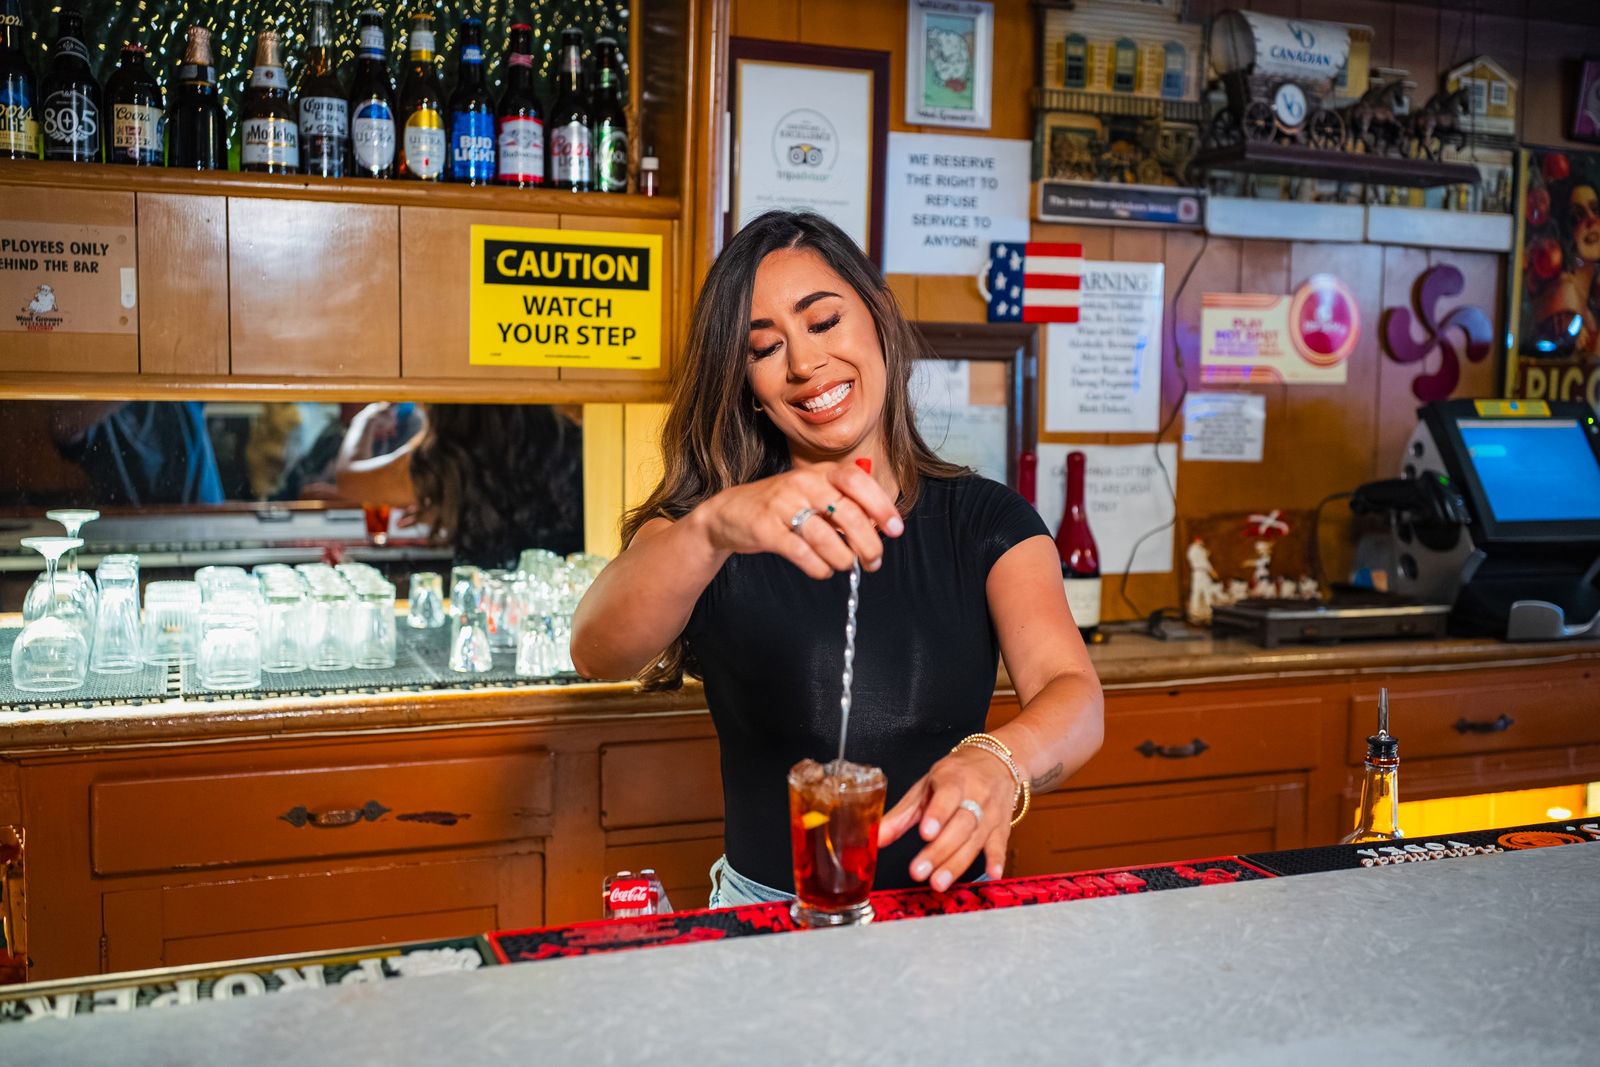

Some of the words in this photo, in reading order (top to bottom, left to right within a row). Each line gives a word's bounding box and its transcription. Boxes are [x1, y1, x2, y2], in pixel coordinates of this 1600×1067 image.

[1269, 45, 1330, 65] CANADIAN
[44, 107, 98, 137] 805
[460, 135, 493, 149] BUD
[454, 149, 495, 163] LIGHT
[909, 153, 928, 166] WE
[933, 154, 995, 169] RESERVE
[906, 173, 931, 187] THE
[936, 175, 976, 189] RIGHT
[981, 176, 998, 190] TO
[926, 194, 978, 208] REFUSE
[913, 215, 970, 229] SERVICE
[974, 216, 991, 229] TO
[70, 242, 109, 256] ONLY
[924, 235, 979, 248] ANYONE
[44, 259, 68, 272] THE
[73, 261, 99, 273] BAR
[496, 248, 639, 282] CAUTION
[1080, 272, 1148, 292] ARNING
[523, 295, 612, 318] WATCH
[498, 322, 569, 345] YOUR
[576, 325, 636, 347] STEP
